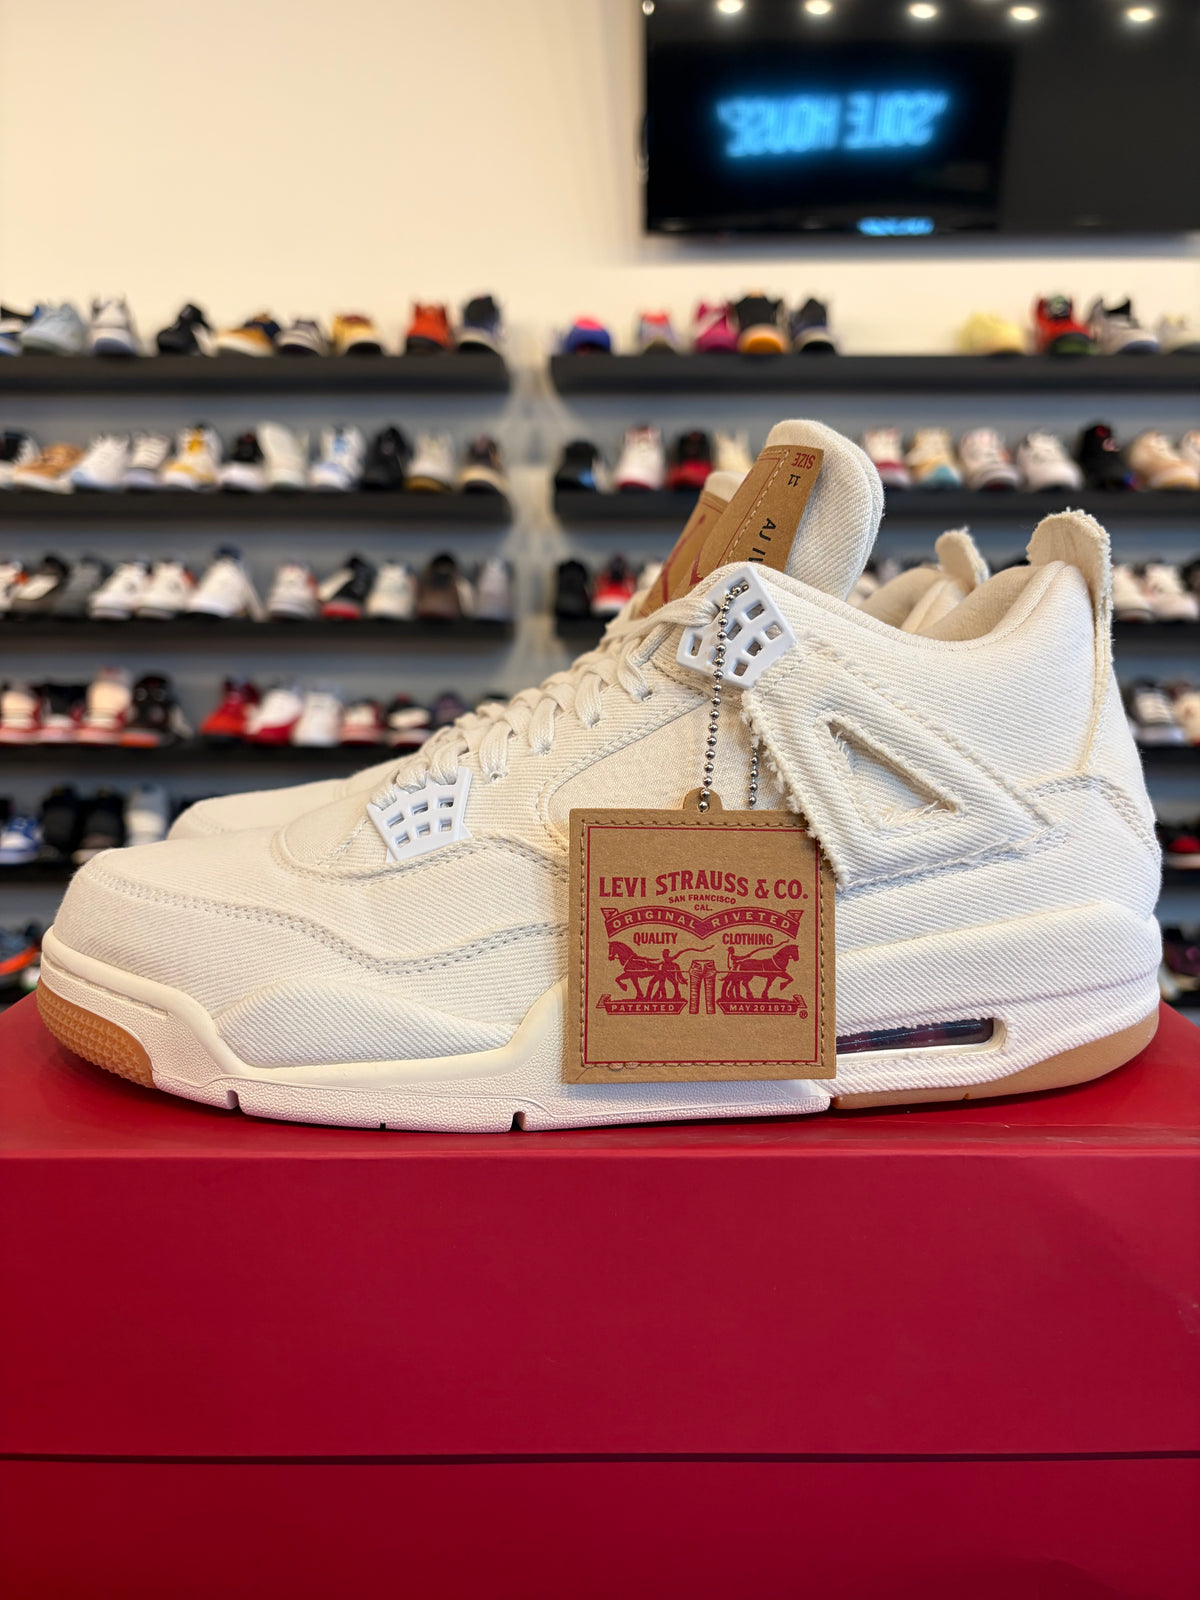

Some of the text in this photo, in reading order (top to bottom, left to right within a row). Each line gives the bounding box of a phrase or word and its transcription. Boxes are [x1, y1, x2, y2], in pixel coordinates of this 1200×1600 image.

[791, 452, 816, 470] SIZE
[787, 474, 801, 487] 11
[759, 517, 776, 542] AJ
[599, 869, 809, 900] LEVI STRAUSS & CO.
[668, 894, 737, 905] SAN FRANCISCO
[694, 903, 713, 912] CAL.
[612, 910, 791, 930] ORIGINAL RIVETED
[633, 932, 774, 946] QUALITY CLOTHING
[611, 1003, 676, 1012] PATENTED
